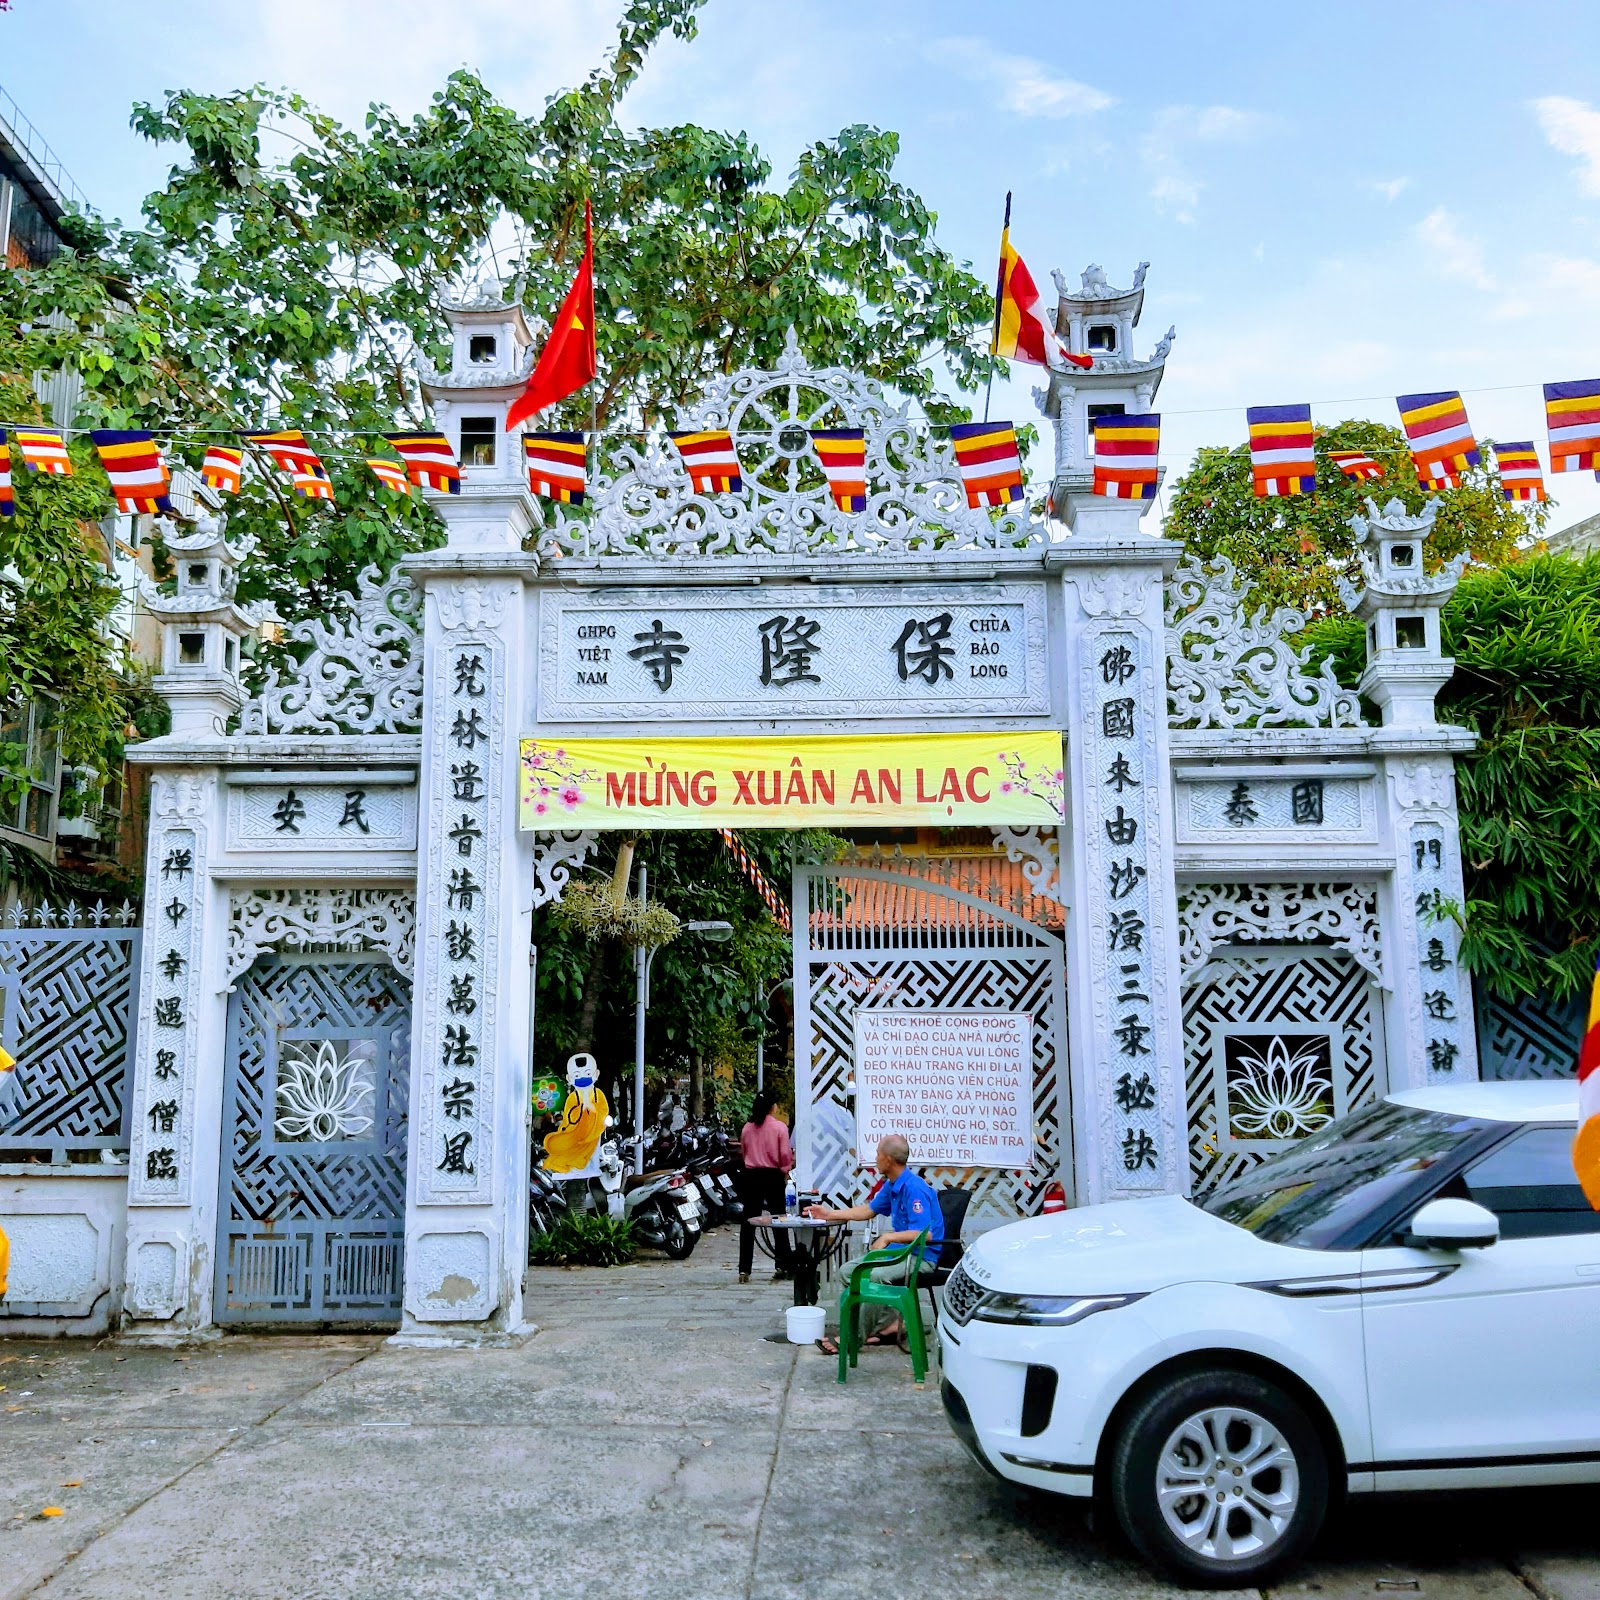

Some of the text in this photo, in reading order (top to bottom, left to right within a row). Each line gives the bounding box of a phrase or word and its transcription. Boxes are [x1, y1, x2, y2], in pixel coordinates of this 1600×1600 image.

[969, 613, 1011, 632] CHÙA
[577, 625, 617, 638] GHPG
[970, 637, 1000, 655] BẢO
[970, 664, 1008, 678] LONG
[577, 671, 608, 684] NAM
[605, 755, 992, 817] MỪNG XUÂN AN LẠC
[272, 789, 371, 834] 民安
[869, 1017, 879, 1027] VÌ
[864, 1030, 879, 1041] VÀ
[959, 1031, 983, 1042] NHÀ
[865, 1045, 888, 1056] QUÝ
[892, 1046, 902, 1058] VỊ
[932, 1045, 962, 1056] CHÙA
[966, 1047, 985, 1057] VUI
[864, 1061, 887, 1070] ĐEO
[926, 1061, 964, 1071] TRANG
[968, 1062, 986, 1071] KHI
[989, 1062, 1001, 1071] ĐI
[864, 1075, 903, 1085] TRONG
[898, 1090, 917, 1099] TAY
[906, 1104, 917, 1114] 30
[993, 1104, 1017, 1116] NÀO
[970, 1120, 989, 1132] HO,
[920, 1134, 950, 1144] QUAY
[1002, 1136, 1024, 1146] TRA
[911, 1147, 924, 1158] VÀ
